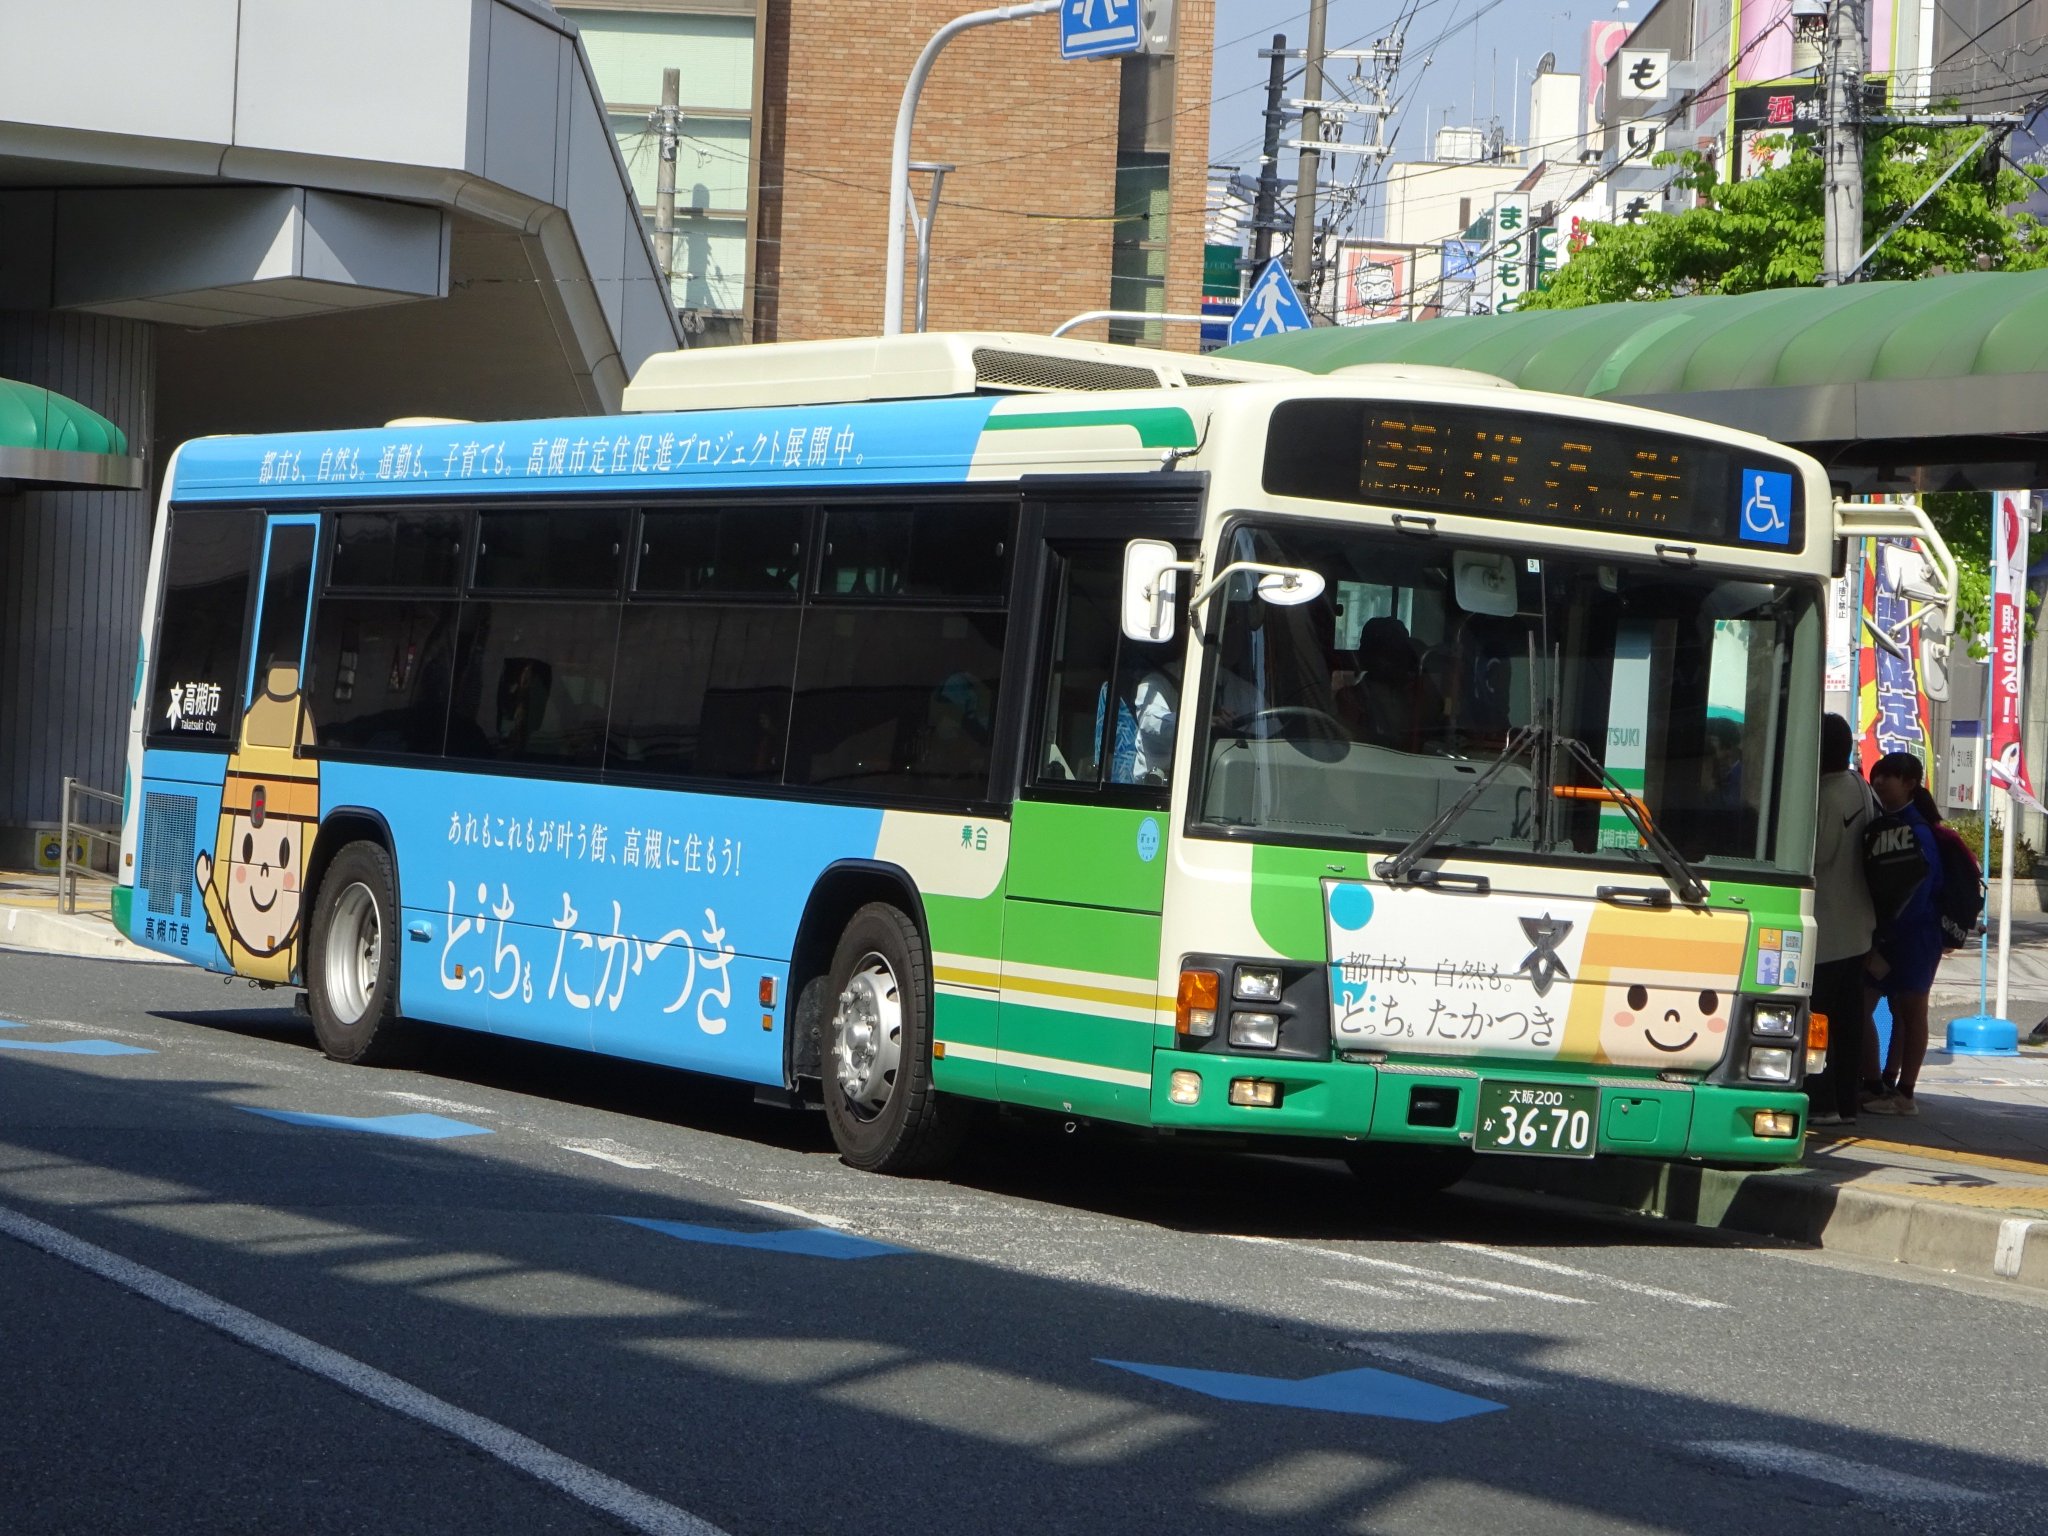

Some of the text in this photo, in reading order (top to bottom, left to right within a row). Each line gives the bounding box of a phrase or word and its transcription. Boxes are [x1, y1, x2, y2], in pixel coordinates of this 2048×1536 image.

[1496, 205, 1523, 314] まつもと
[182, 681, 223, 717] 高槻市
[181, 718, 217, 734] Takatsuki City
[145, 916, 190, 946] 高槻市営
[548, 892, 736, 1036] たかつき
[1342, 951, 1512, 993] 都市も、自然も。
[1426, 998, 1555, 1047] たかつき
[1483, 1105, 1590, 1150] か 36-70
